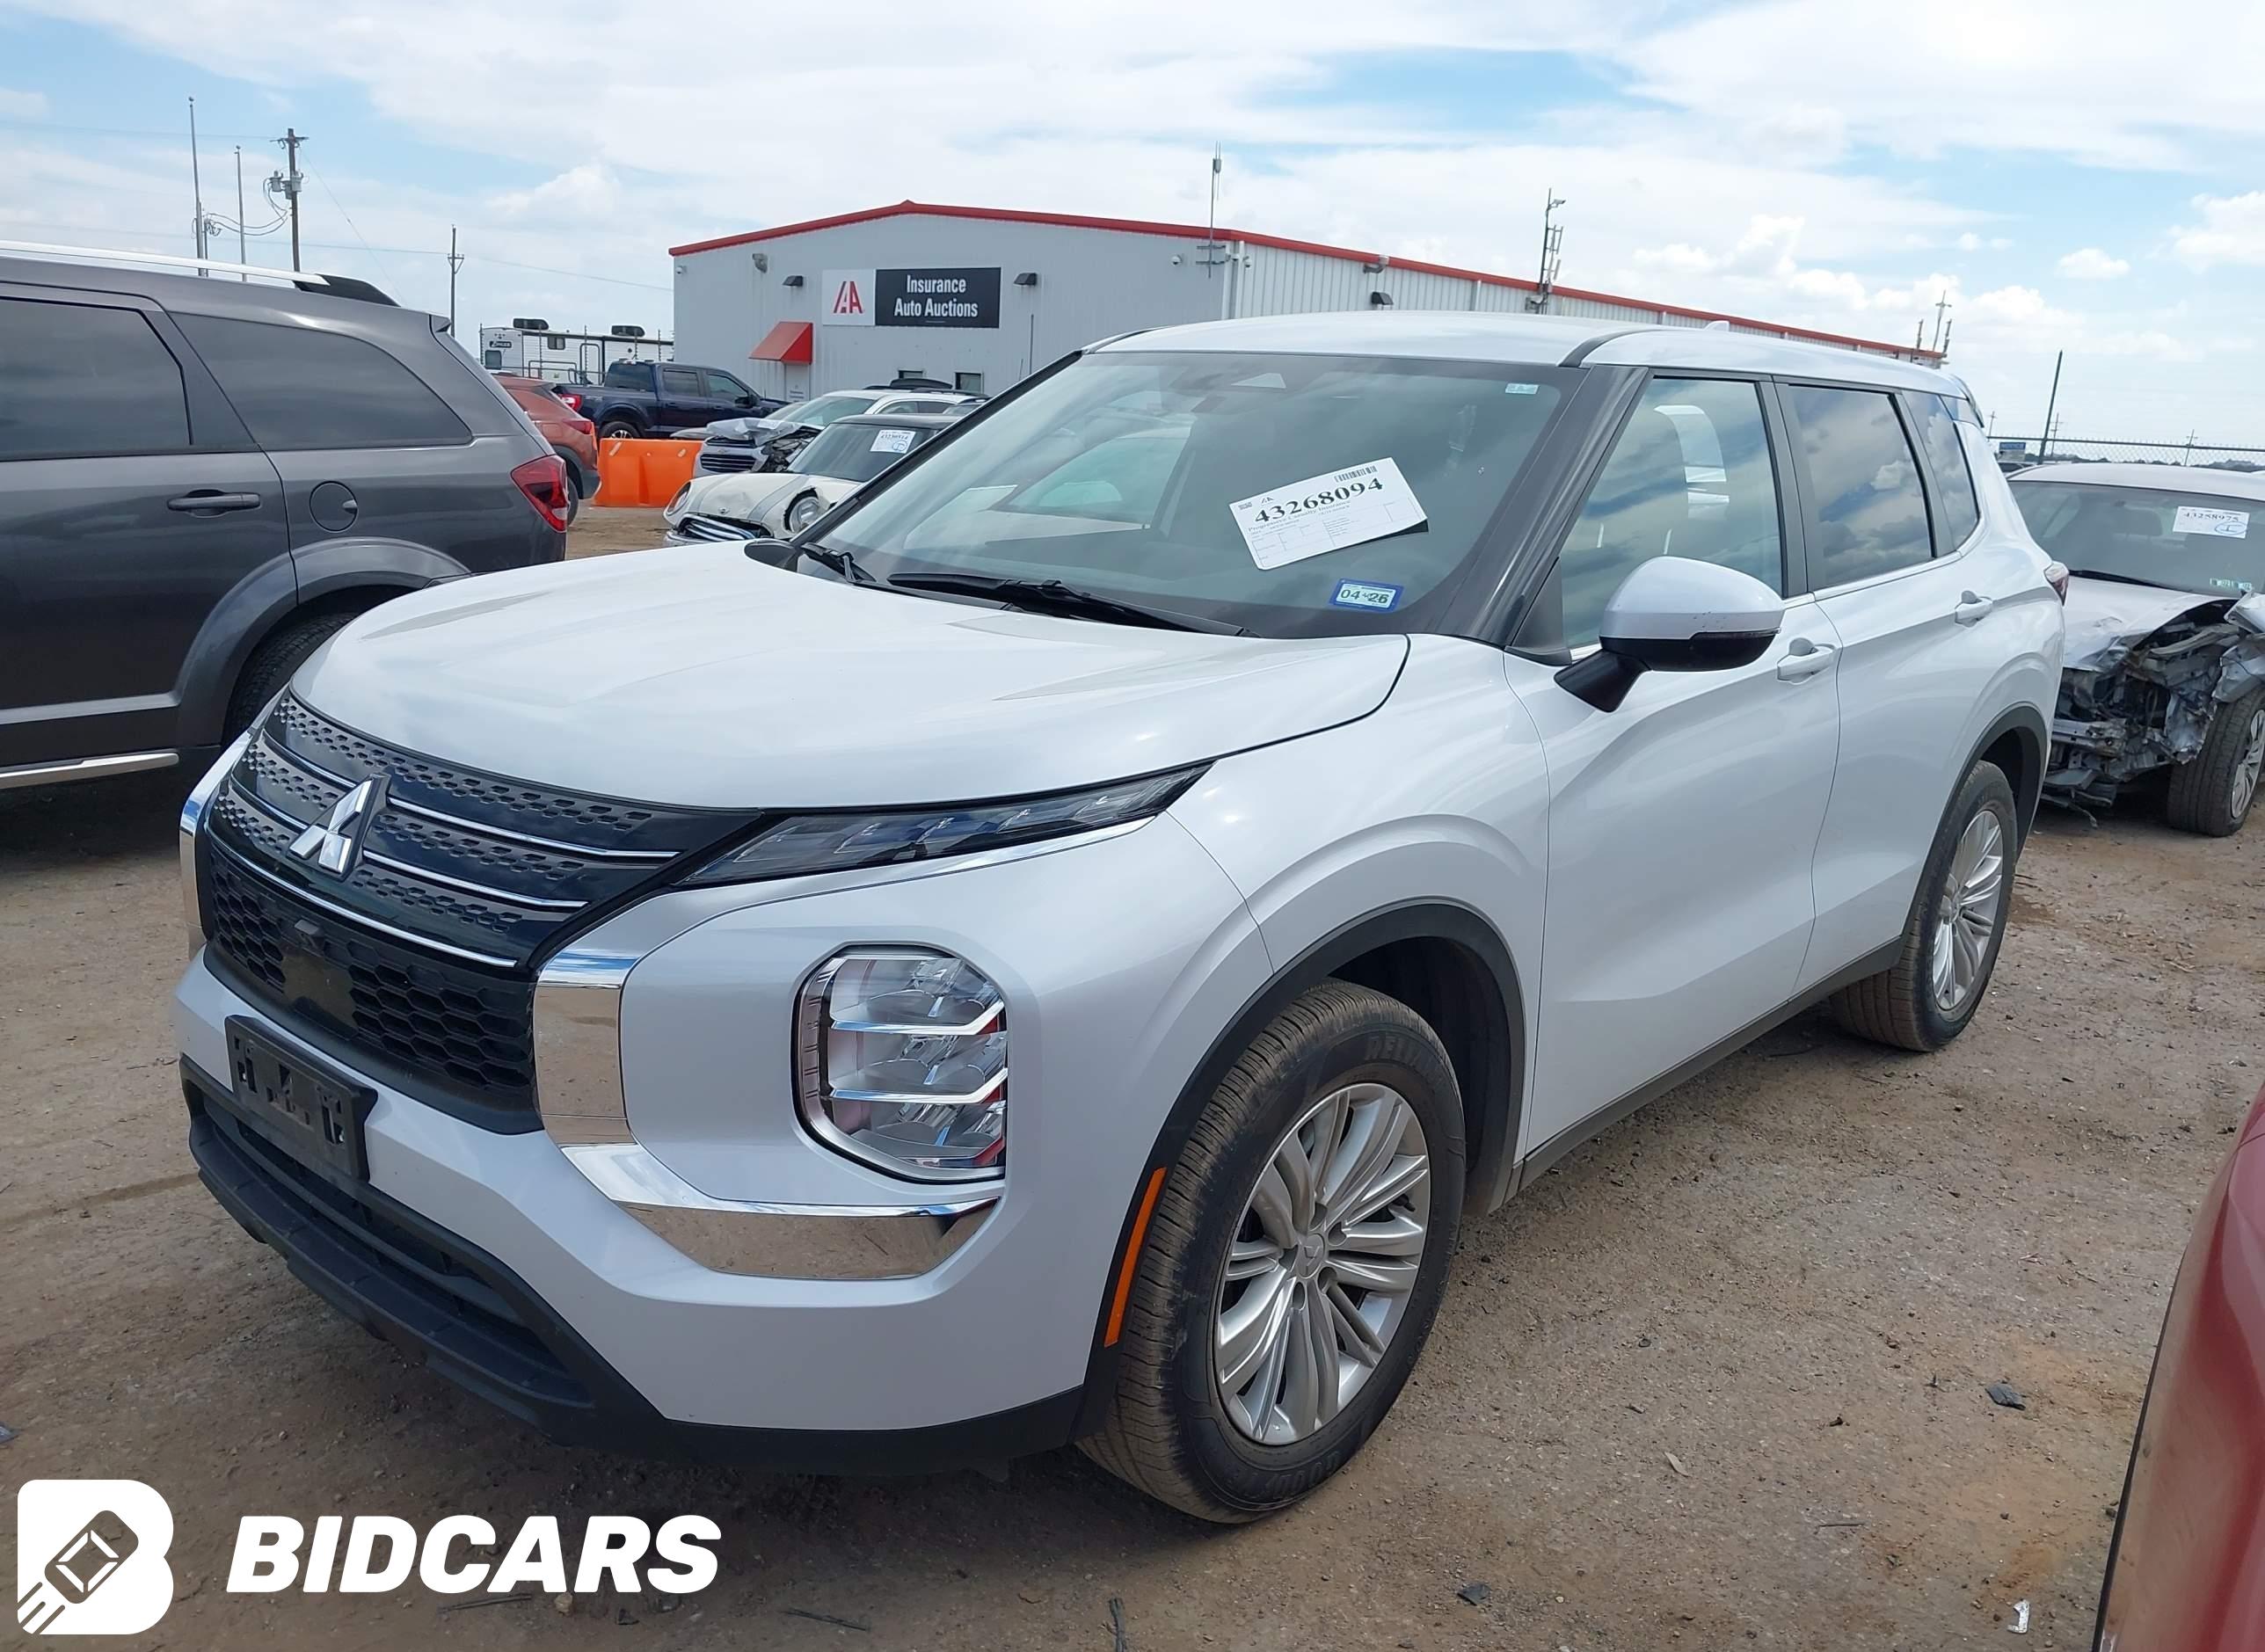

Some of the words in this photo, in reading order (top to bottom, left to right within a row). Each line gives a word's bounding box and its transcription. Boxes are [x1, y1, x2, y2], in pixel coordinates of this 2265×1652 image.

[907, 274, 966, 293] Insurance
[893, 298, 922, 317] Auto
[924, 298, 979, 317] Auctions
[1254, 477, 1384, 524] 43268094
[1340, 589, 1361, 600] 04
[1368, 593, 1389, 604] 26
